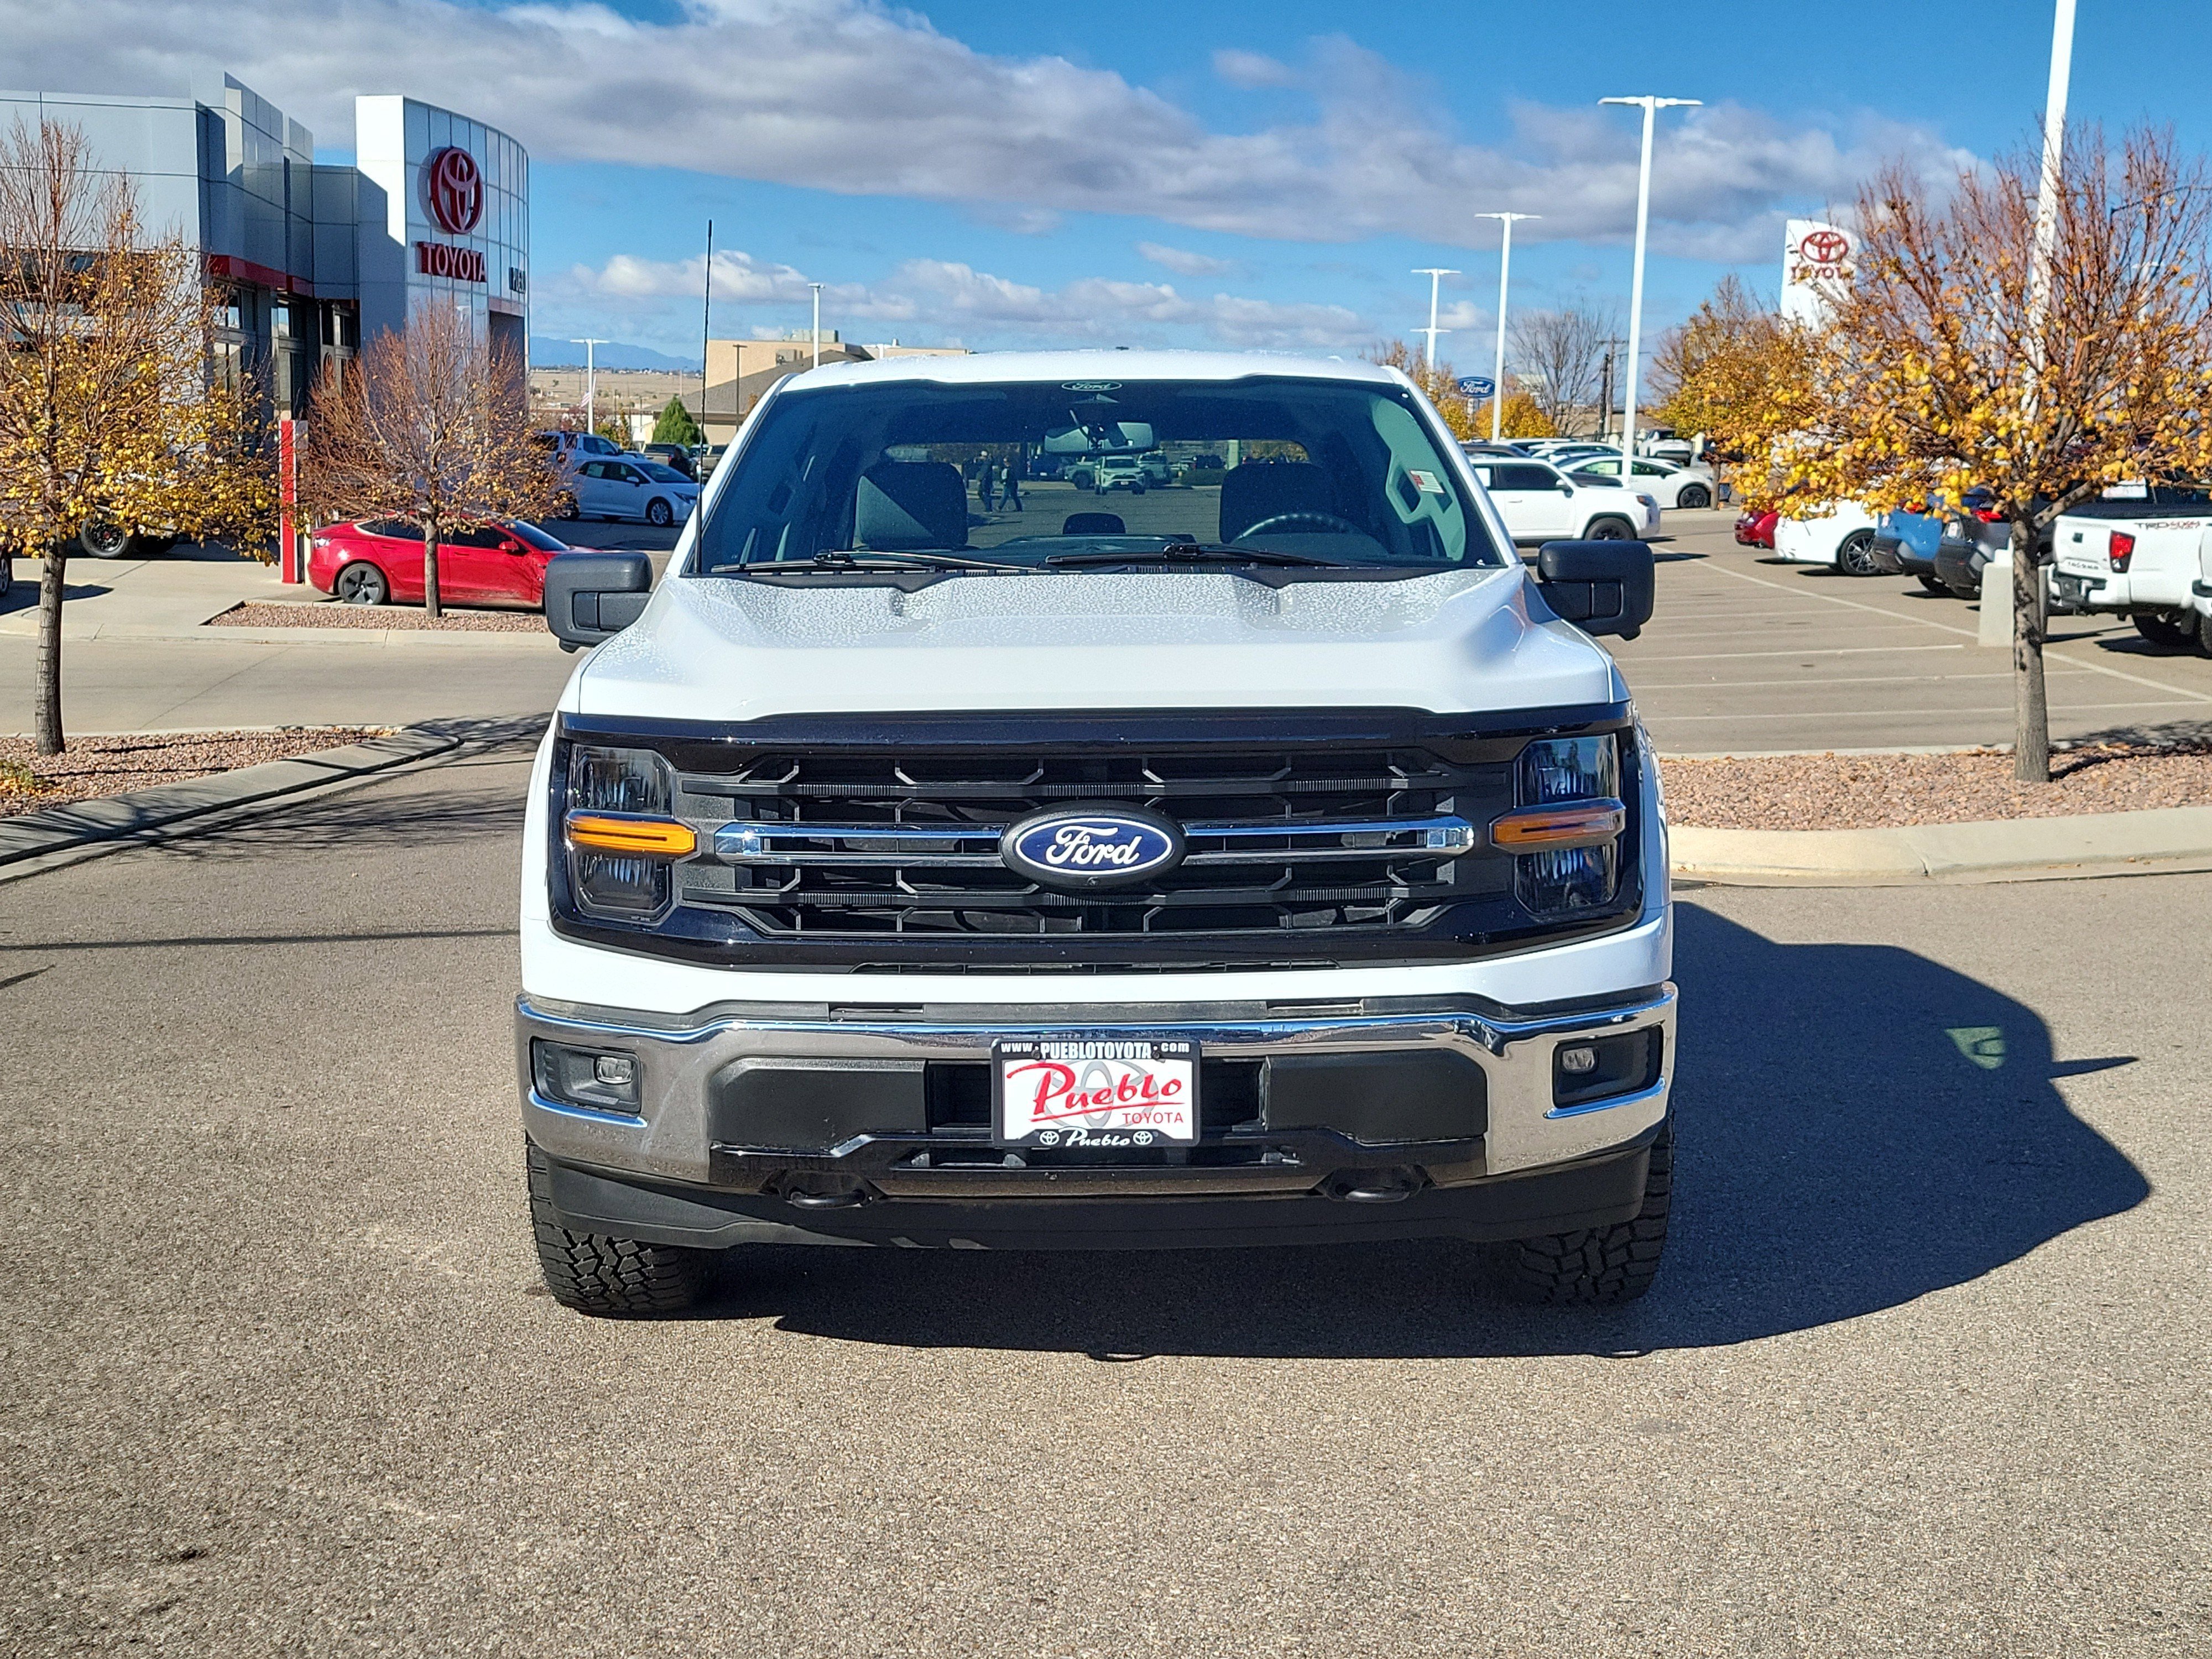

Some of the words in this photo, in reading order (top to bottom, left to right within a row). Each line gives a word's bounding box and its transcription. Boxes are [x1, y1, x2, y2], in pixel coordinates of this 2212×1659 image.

[418, 242, 487, 283] TOYOTA
[1460, 380, 1492, 393] Ford
[1046, 826, 1142, 864] Ford
[1006, 1062, 1182, 1115] Pueblo
[1122, 1112, 1184, 1124] TOYOTA
[1058, 1126, 1131, 1146] Pueblo
